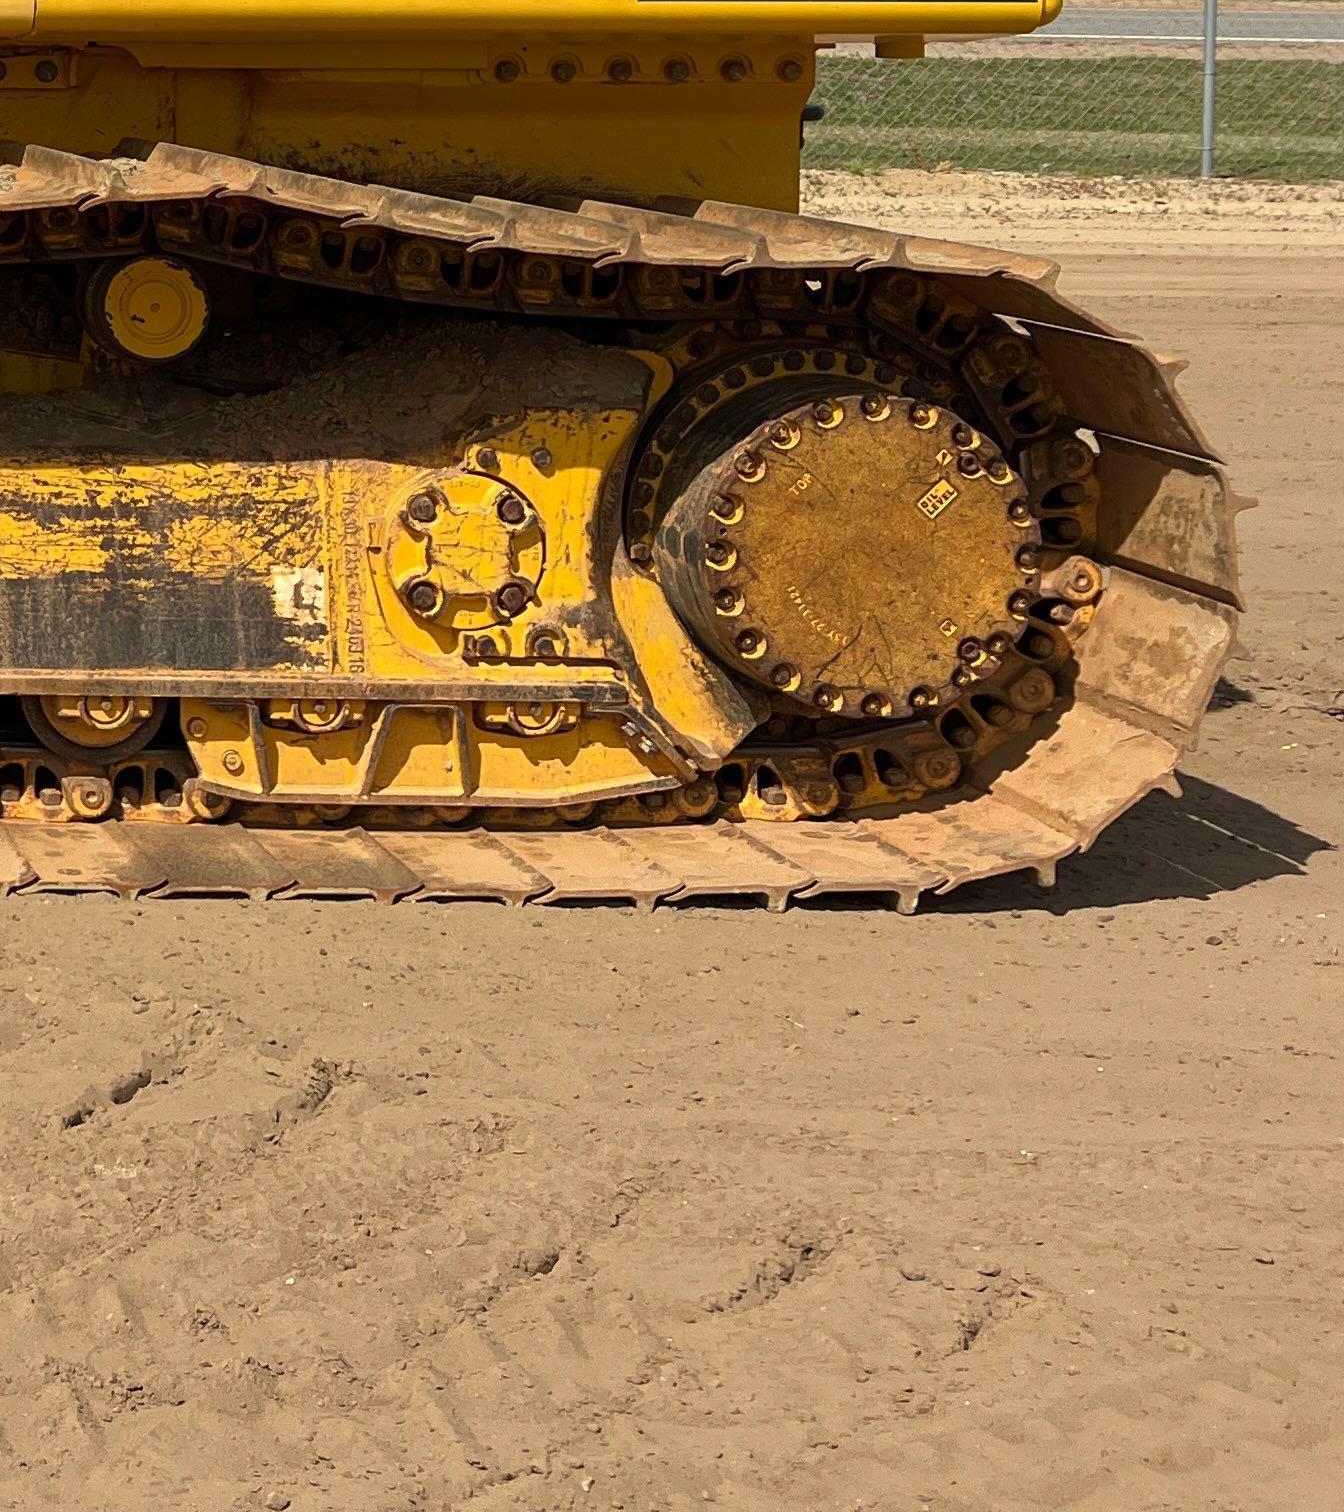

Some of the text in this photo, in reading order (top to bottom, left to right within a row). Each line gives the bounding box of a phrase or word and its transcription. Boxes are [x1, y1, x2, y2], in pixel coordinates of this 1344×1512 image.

[788, 472, 812, 496] TOP
[920, 492, 939, 509] OIL
[926, 489, 956, 516] LEVEL
